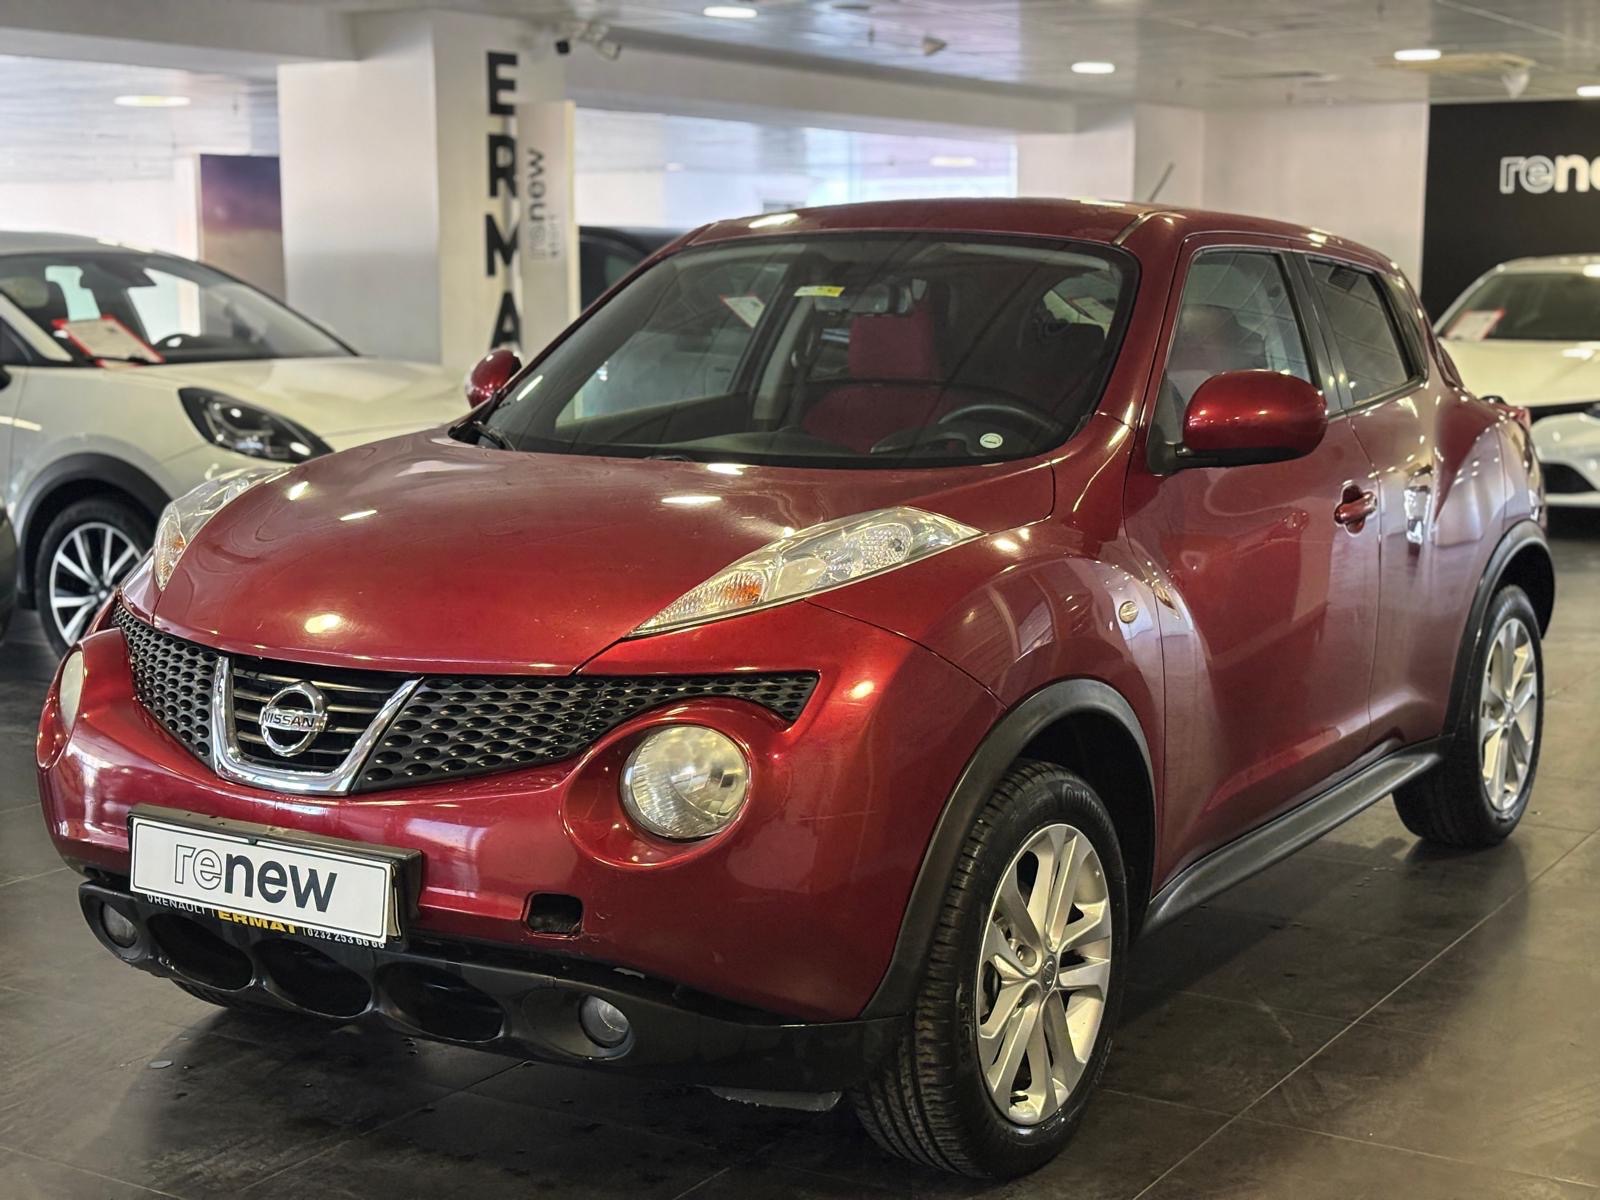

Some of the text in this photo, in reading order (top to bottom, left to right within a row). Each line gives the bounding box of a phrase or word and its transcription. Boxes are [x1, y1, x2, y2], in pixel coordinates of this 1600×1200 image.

[262, 711, 315, 728] NISSAN
[174, 843, 338, 913] renew
[154, 895, 207, 915] RENAULT
[217, 910, 297, 935] ERMAT
